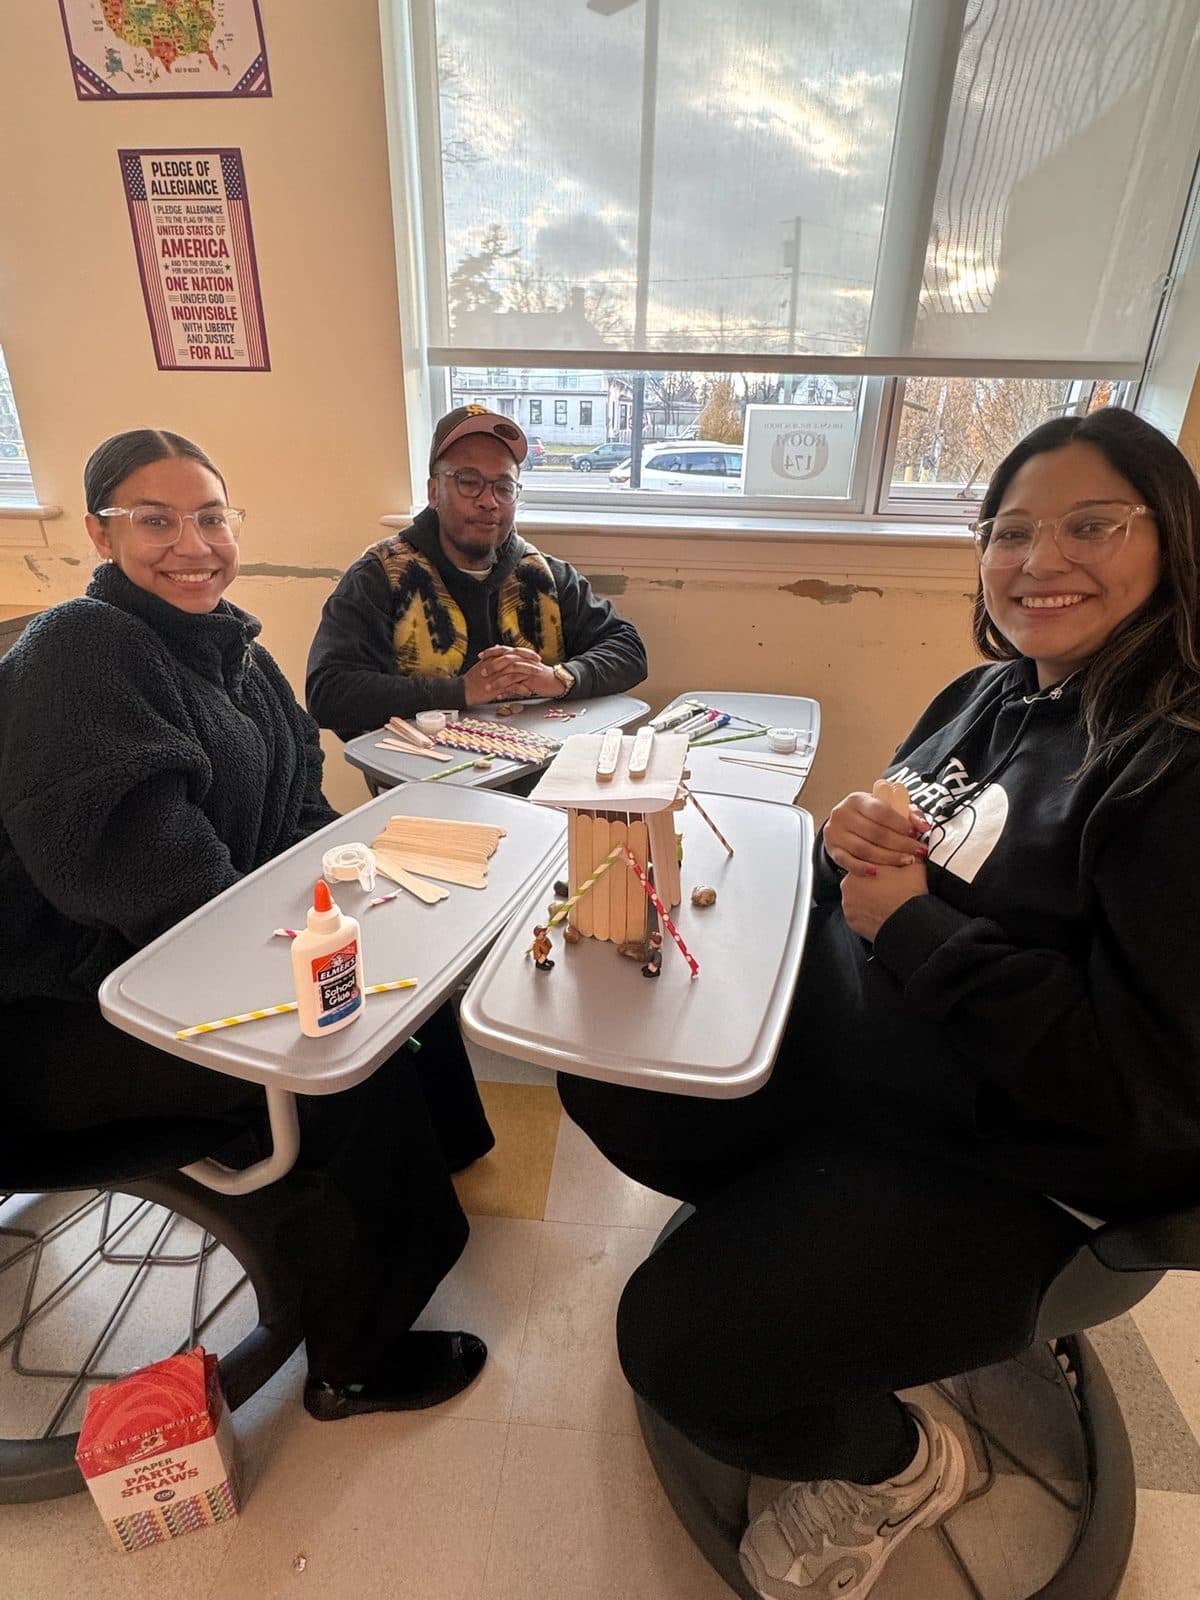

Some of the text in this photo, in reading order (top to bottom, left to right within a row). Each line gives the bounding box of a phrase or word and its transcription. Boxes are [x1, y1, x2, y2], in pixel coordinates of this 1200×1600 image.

[151, 161, 210, 178] PLEDGE OF
[151, 180, 219, 195] ALLEGIANCE
[157, 205, 182, 214] PLEDGE
[186, 205, 224, 214] ALLEGIANCE
[157, 225, 226, 235] UNITED STATES OF
[162, 238, 230, 258] AMERICA
[165, 276, 234, 291] ONE NATION
[180, 293, 225, 304] UNDER GOD
[171, 306, 238, 320] INDIVISIBLE
[182, 322, 235, 332] WITH LIBERTY
[186, 334, 235, 344] AND JUSTICE
[190, 346, 235, 360] FOR ALL
[324, 976, 355, 999] School
[329, 992, 351, 1005] Glue
[133, 1457, 174, 1475] PAPER
[124, 1460, 188, 1487] PARTY
[121, 1467, 199, 1498] STRAWS
